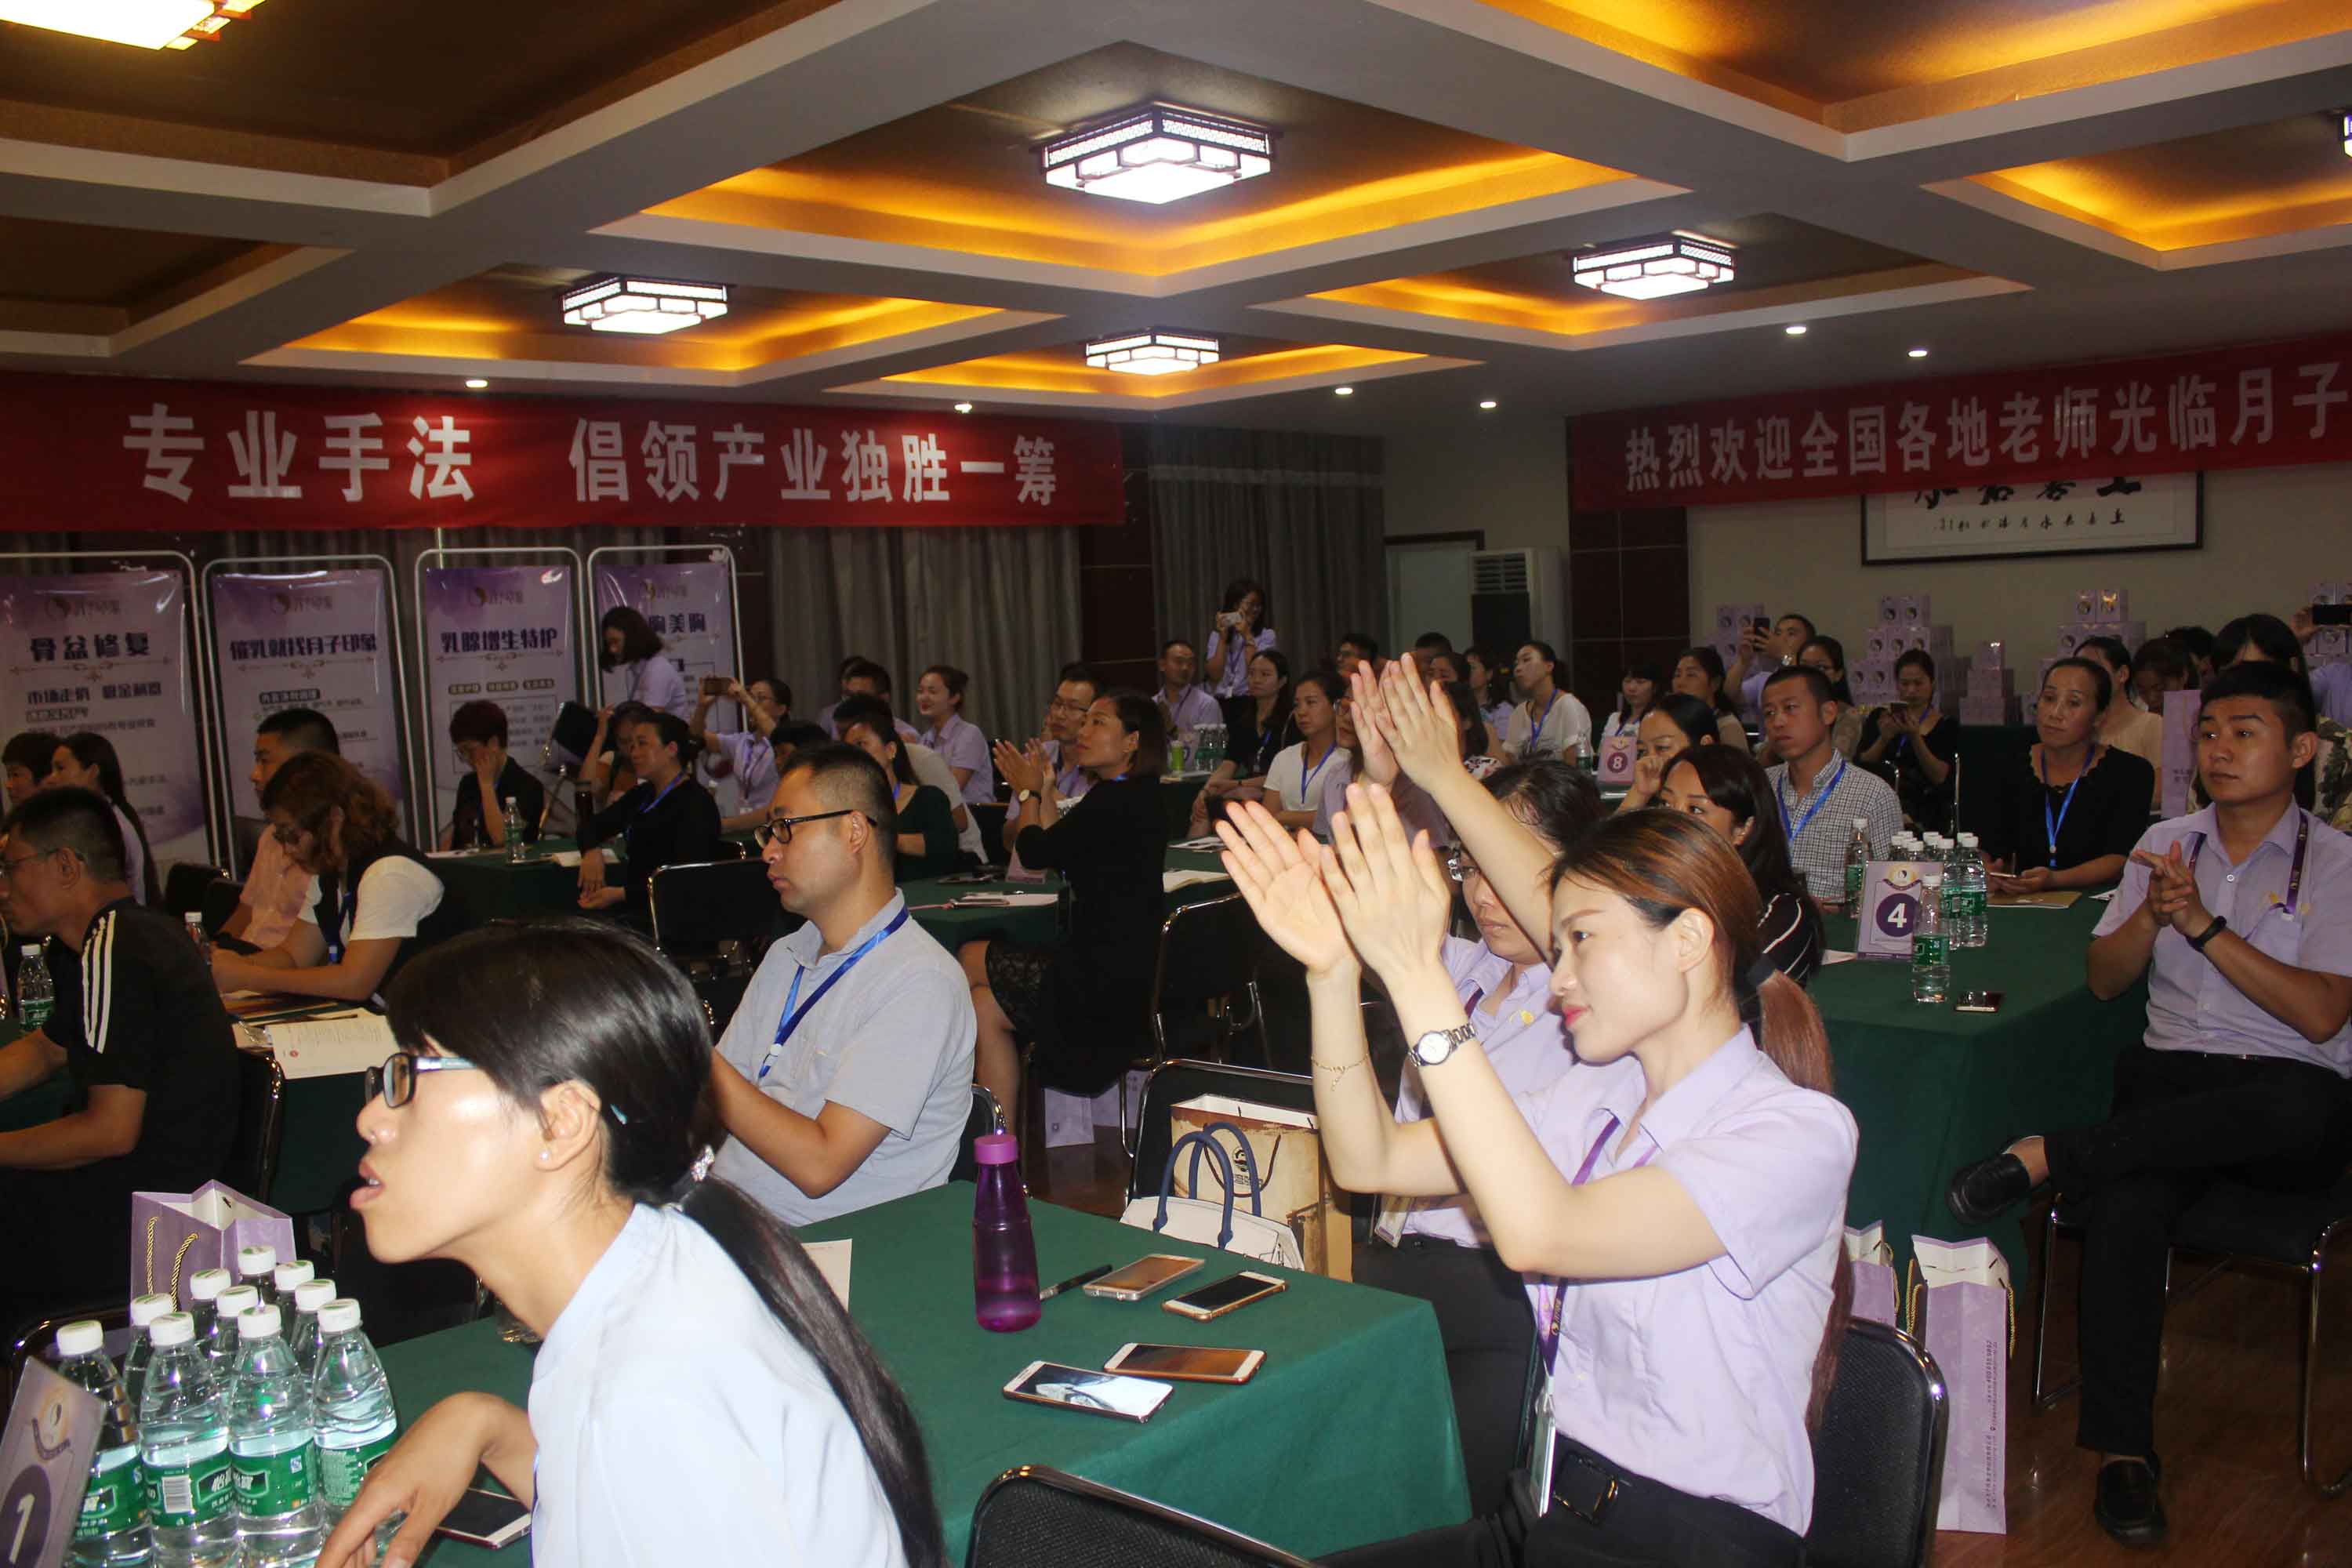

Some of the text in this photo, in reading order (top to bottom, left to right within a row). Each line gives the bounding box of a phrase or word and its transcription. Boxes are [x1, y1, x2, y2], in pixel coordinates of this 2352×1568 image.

[1625, 361, 2348, 492] 热烈欢迎全国各地老师光临月子
[122, 401, 1058, 506] 专业手法 倡领产业独胜一筹
[648, 612, 705, 633] 胸美胸
[30, 632, 150, 662] 骨盆修复
[441, 627, 558, 653] 乳腺增生特护
[1613, 756, 1623, 770] 8
[1887, 902, 1907, 928] 4
[9, 1493, 36, 1565] 1
